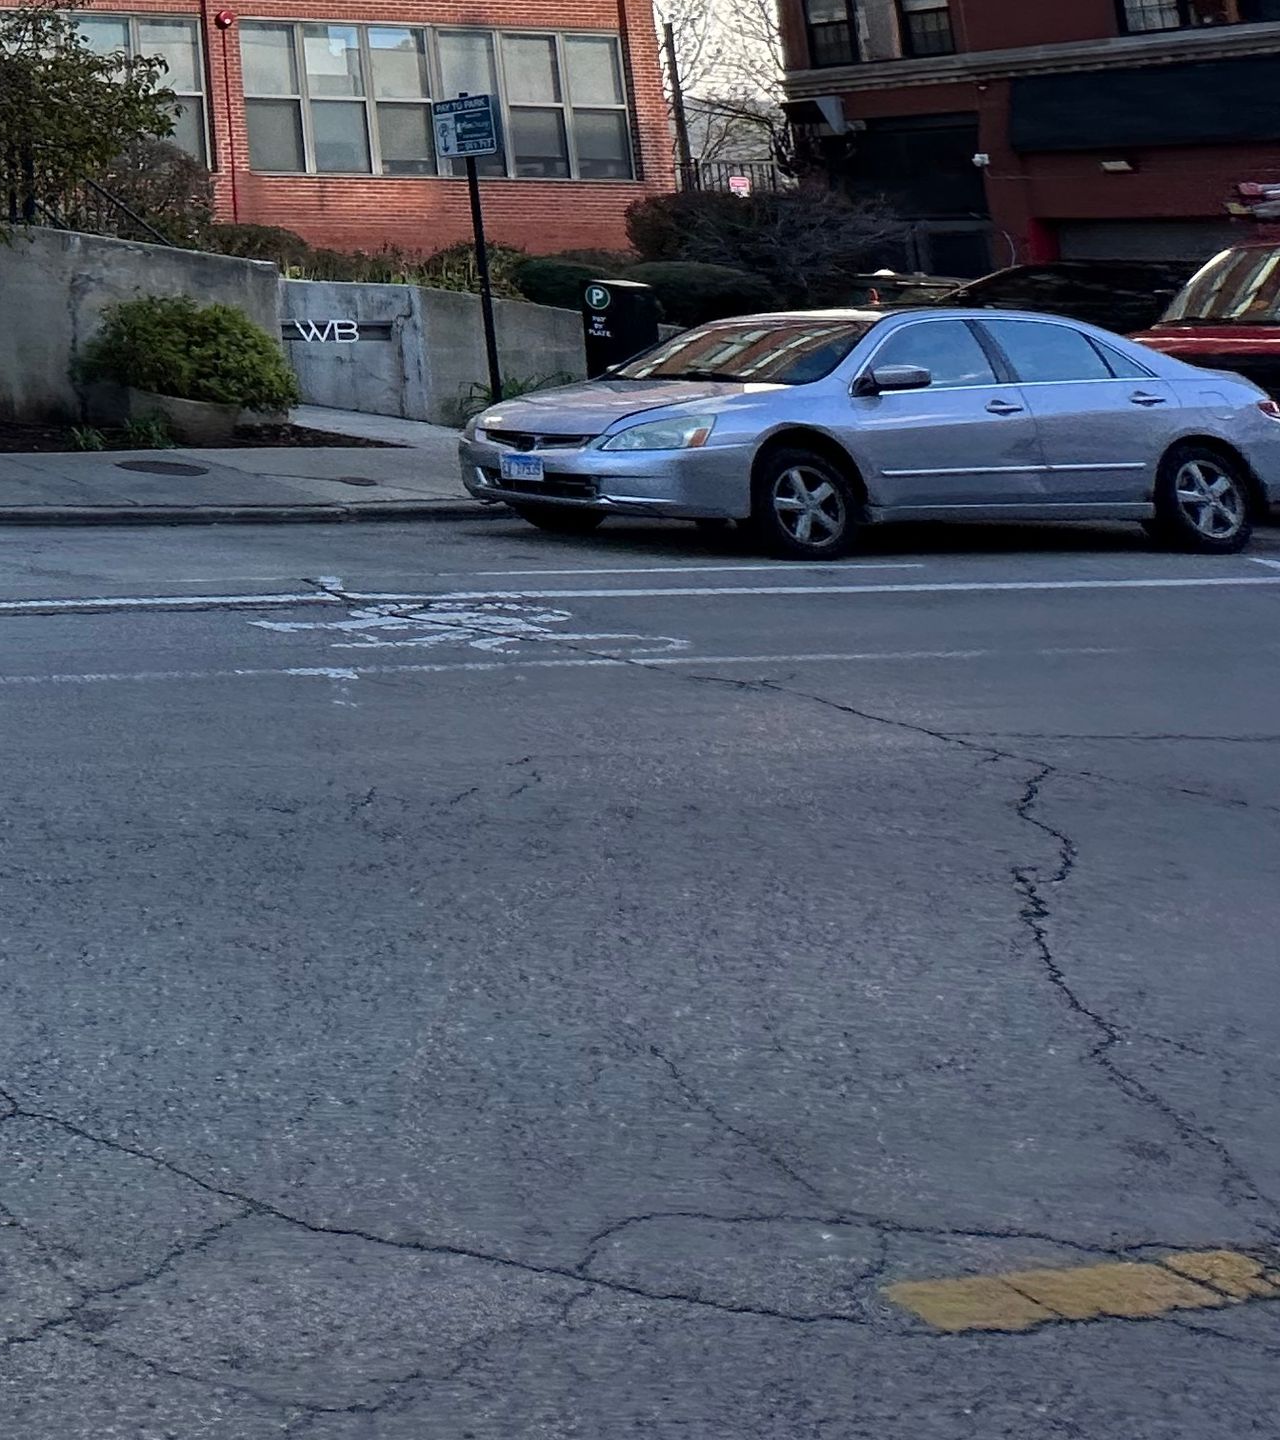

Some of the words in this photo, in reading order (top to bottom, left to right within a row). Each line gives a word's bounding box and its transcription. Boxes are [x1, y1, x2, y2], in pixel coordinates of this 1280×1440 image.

[436, 103, 450, 113] PAY
[451, 101, 463, 110] TO
[464, 98, 485, 110] PARK
[294, 319, 360, 343] WB
